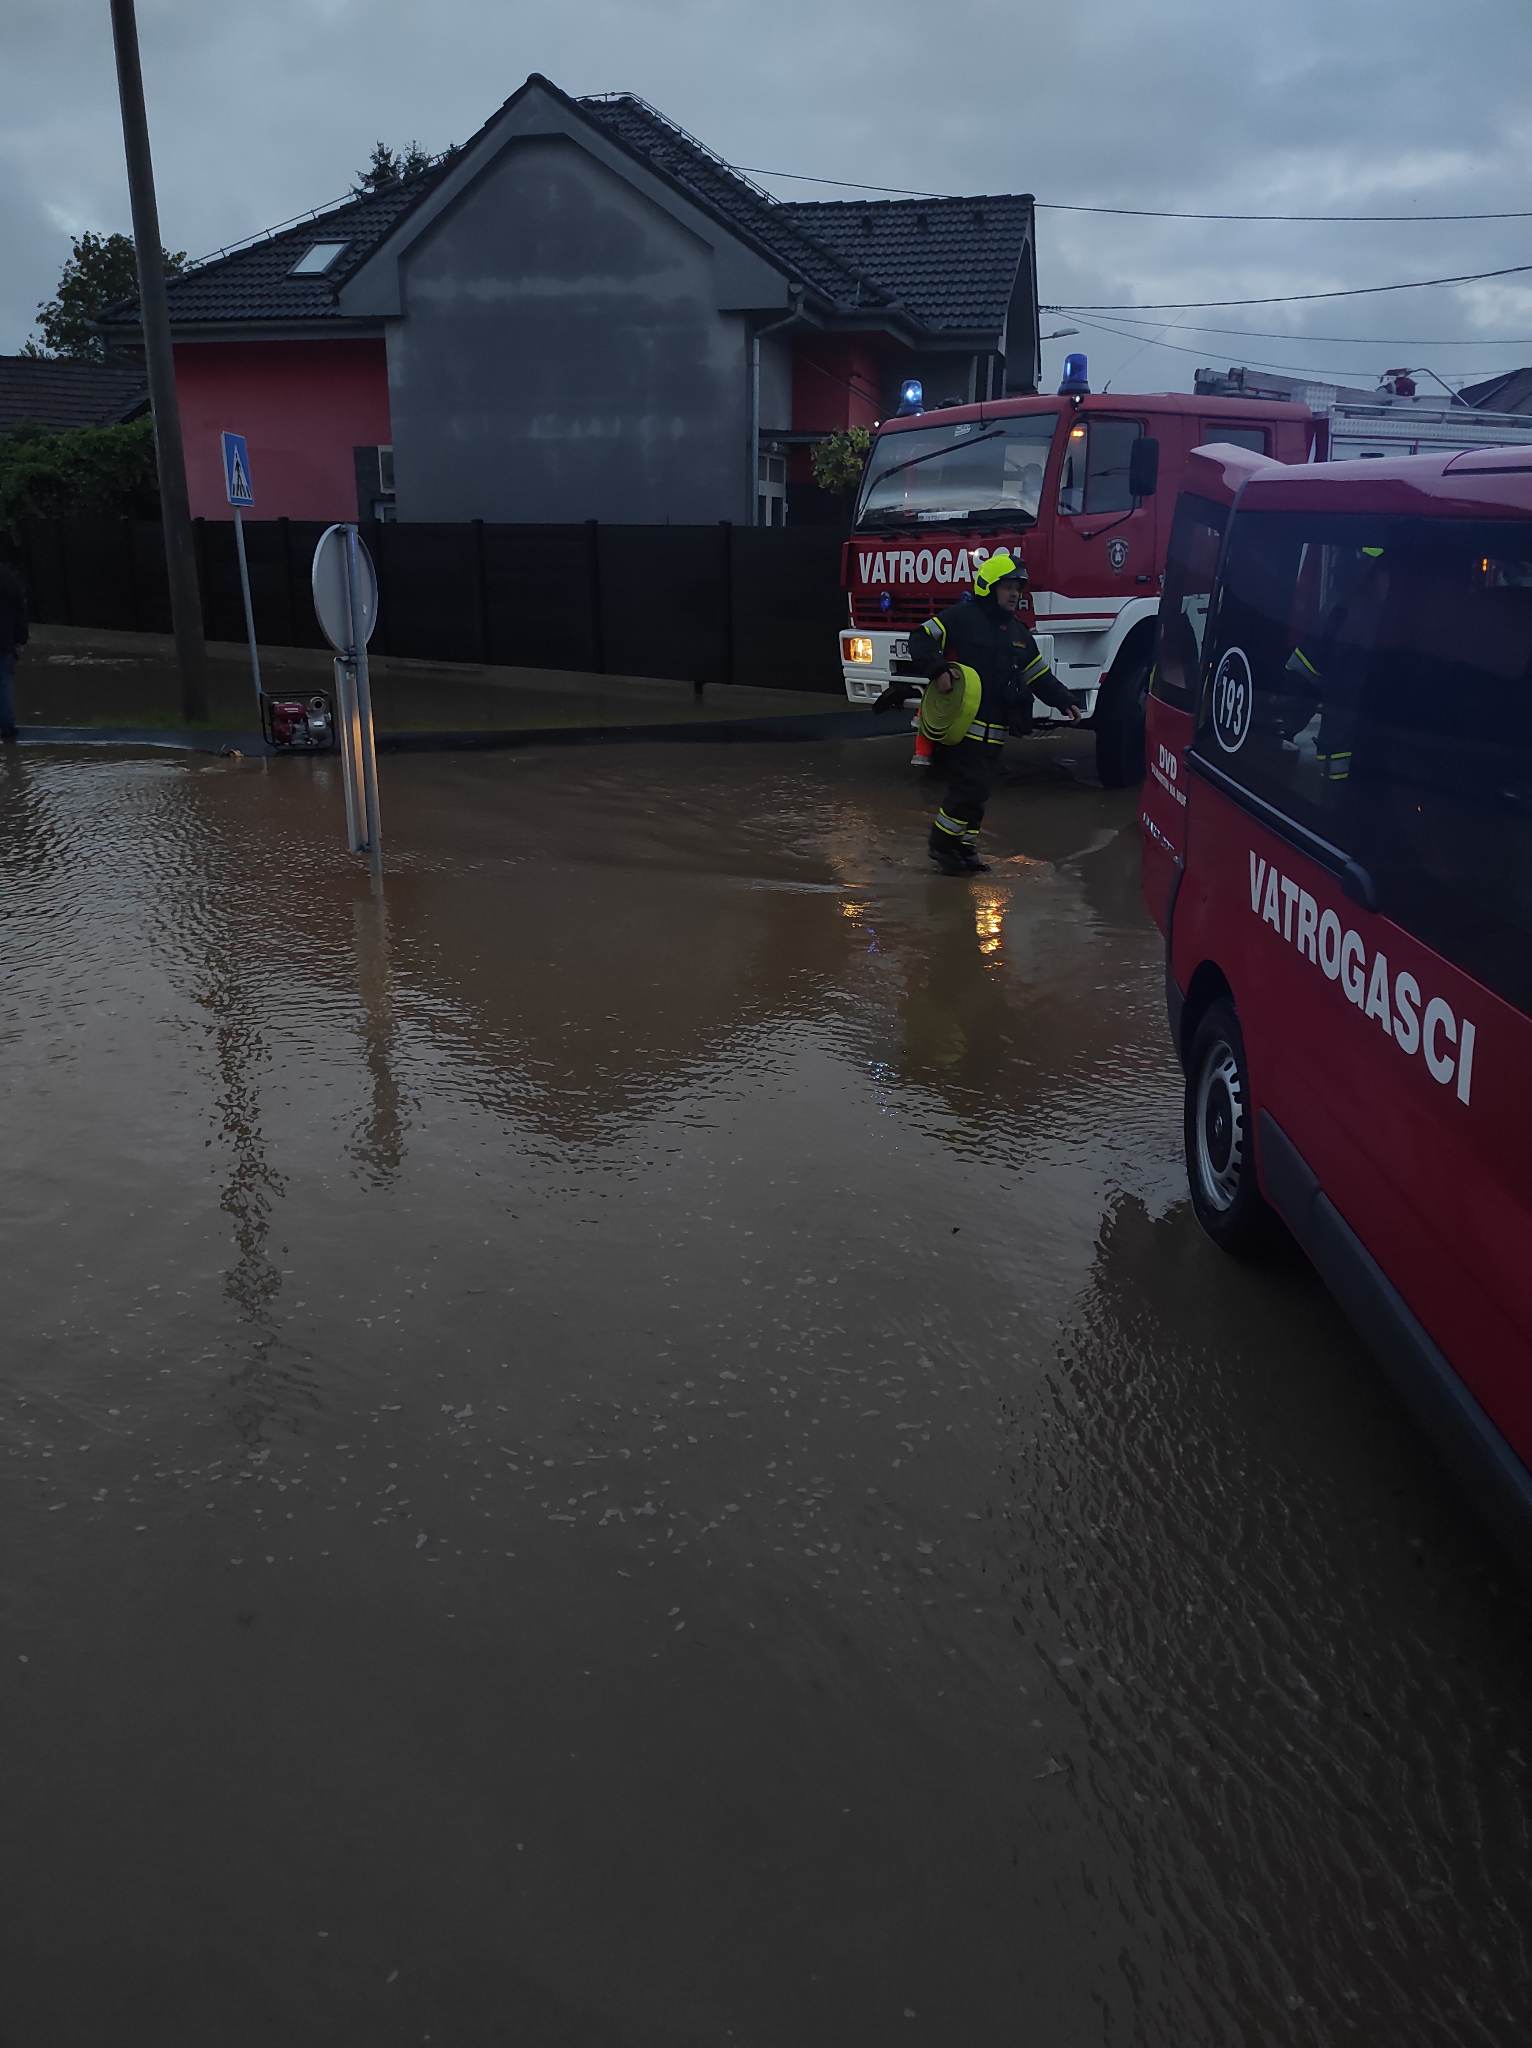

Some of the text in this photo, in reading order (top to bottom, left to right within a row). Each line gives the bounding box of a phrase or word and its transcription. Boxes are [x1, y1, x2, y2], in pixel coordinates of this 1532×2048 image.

[858, 547, 1021, 583] VATROGAS
[1219, 675, 1244, 736] 193
[1159, 744, 1177, 780] DVD
[1249, 850, 1476, 1106] VATROGASCI
